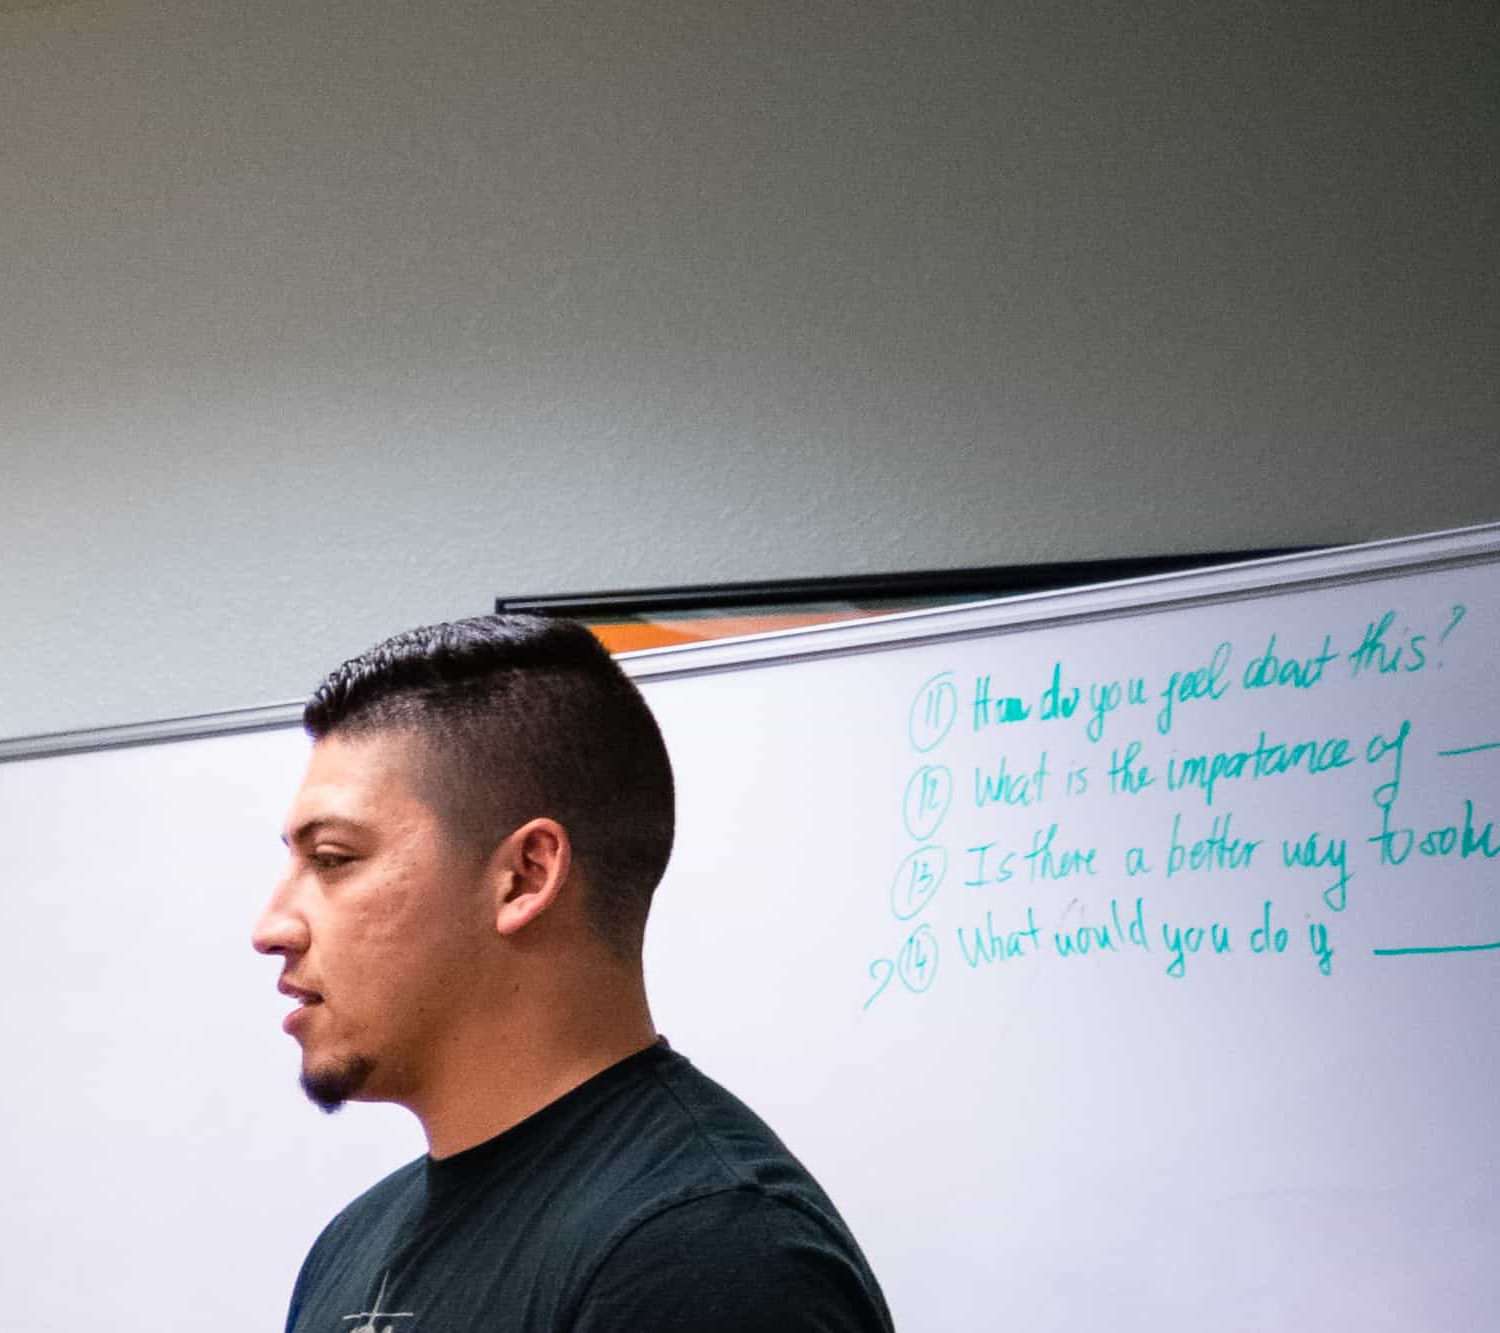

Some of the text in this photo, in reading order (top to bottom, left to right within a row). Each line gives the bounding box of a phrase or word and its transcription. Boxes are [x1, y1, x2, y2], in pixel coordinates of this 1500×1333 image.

[1085, 677, 1148, 743] you
[1242, 633, 1340, 690] about
[974, 750, 1051, 808] What
[1065, 760, 1089, 798] is
[1107, 740, 1157, 795] the
[1166, 730, 1356, 806] importance
[1365, 719, 1412, 808] of
[963, 842, 1017, 887] Is
[1022, 822, 1099, 884] there
[1125, 847, 1152, 878] a
[1164, 811, 1264, 879] better
[1282, 831, 1356, 912] way
[1366, 801, 1415, 866] to
[957, 906, 1041, 968] What
[1054, 896, 1150, 957] would
[1162, 921, 1231, 979] you
[1249, 899, 1289, 954] do
